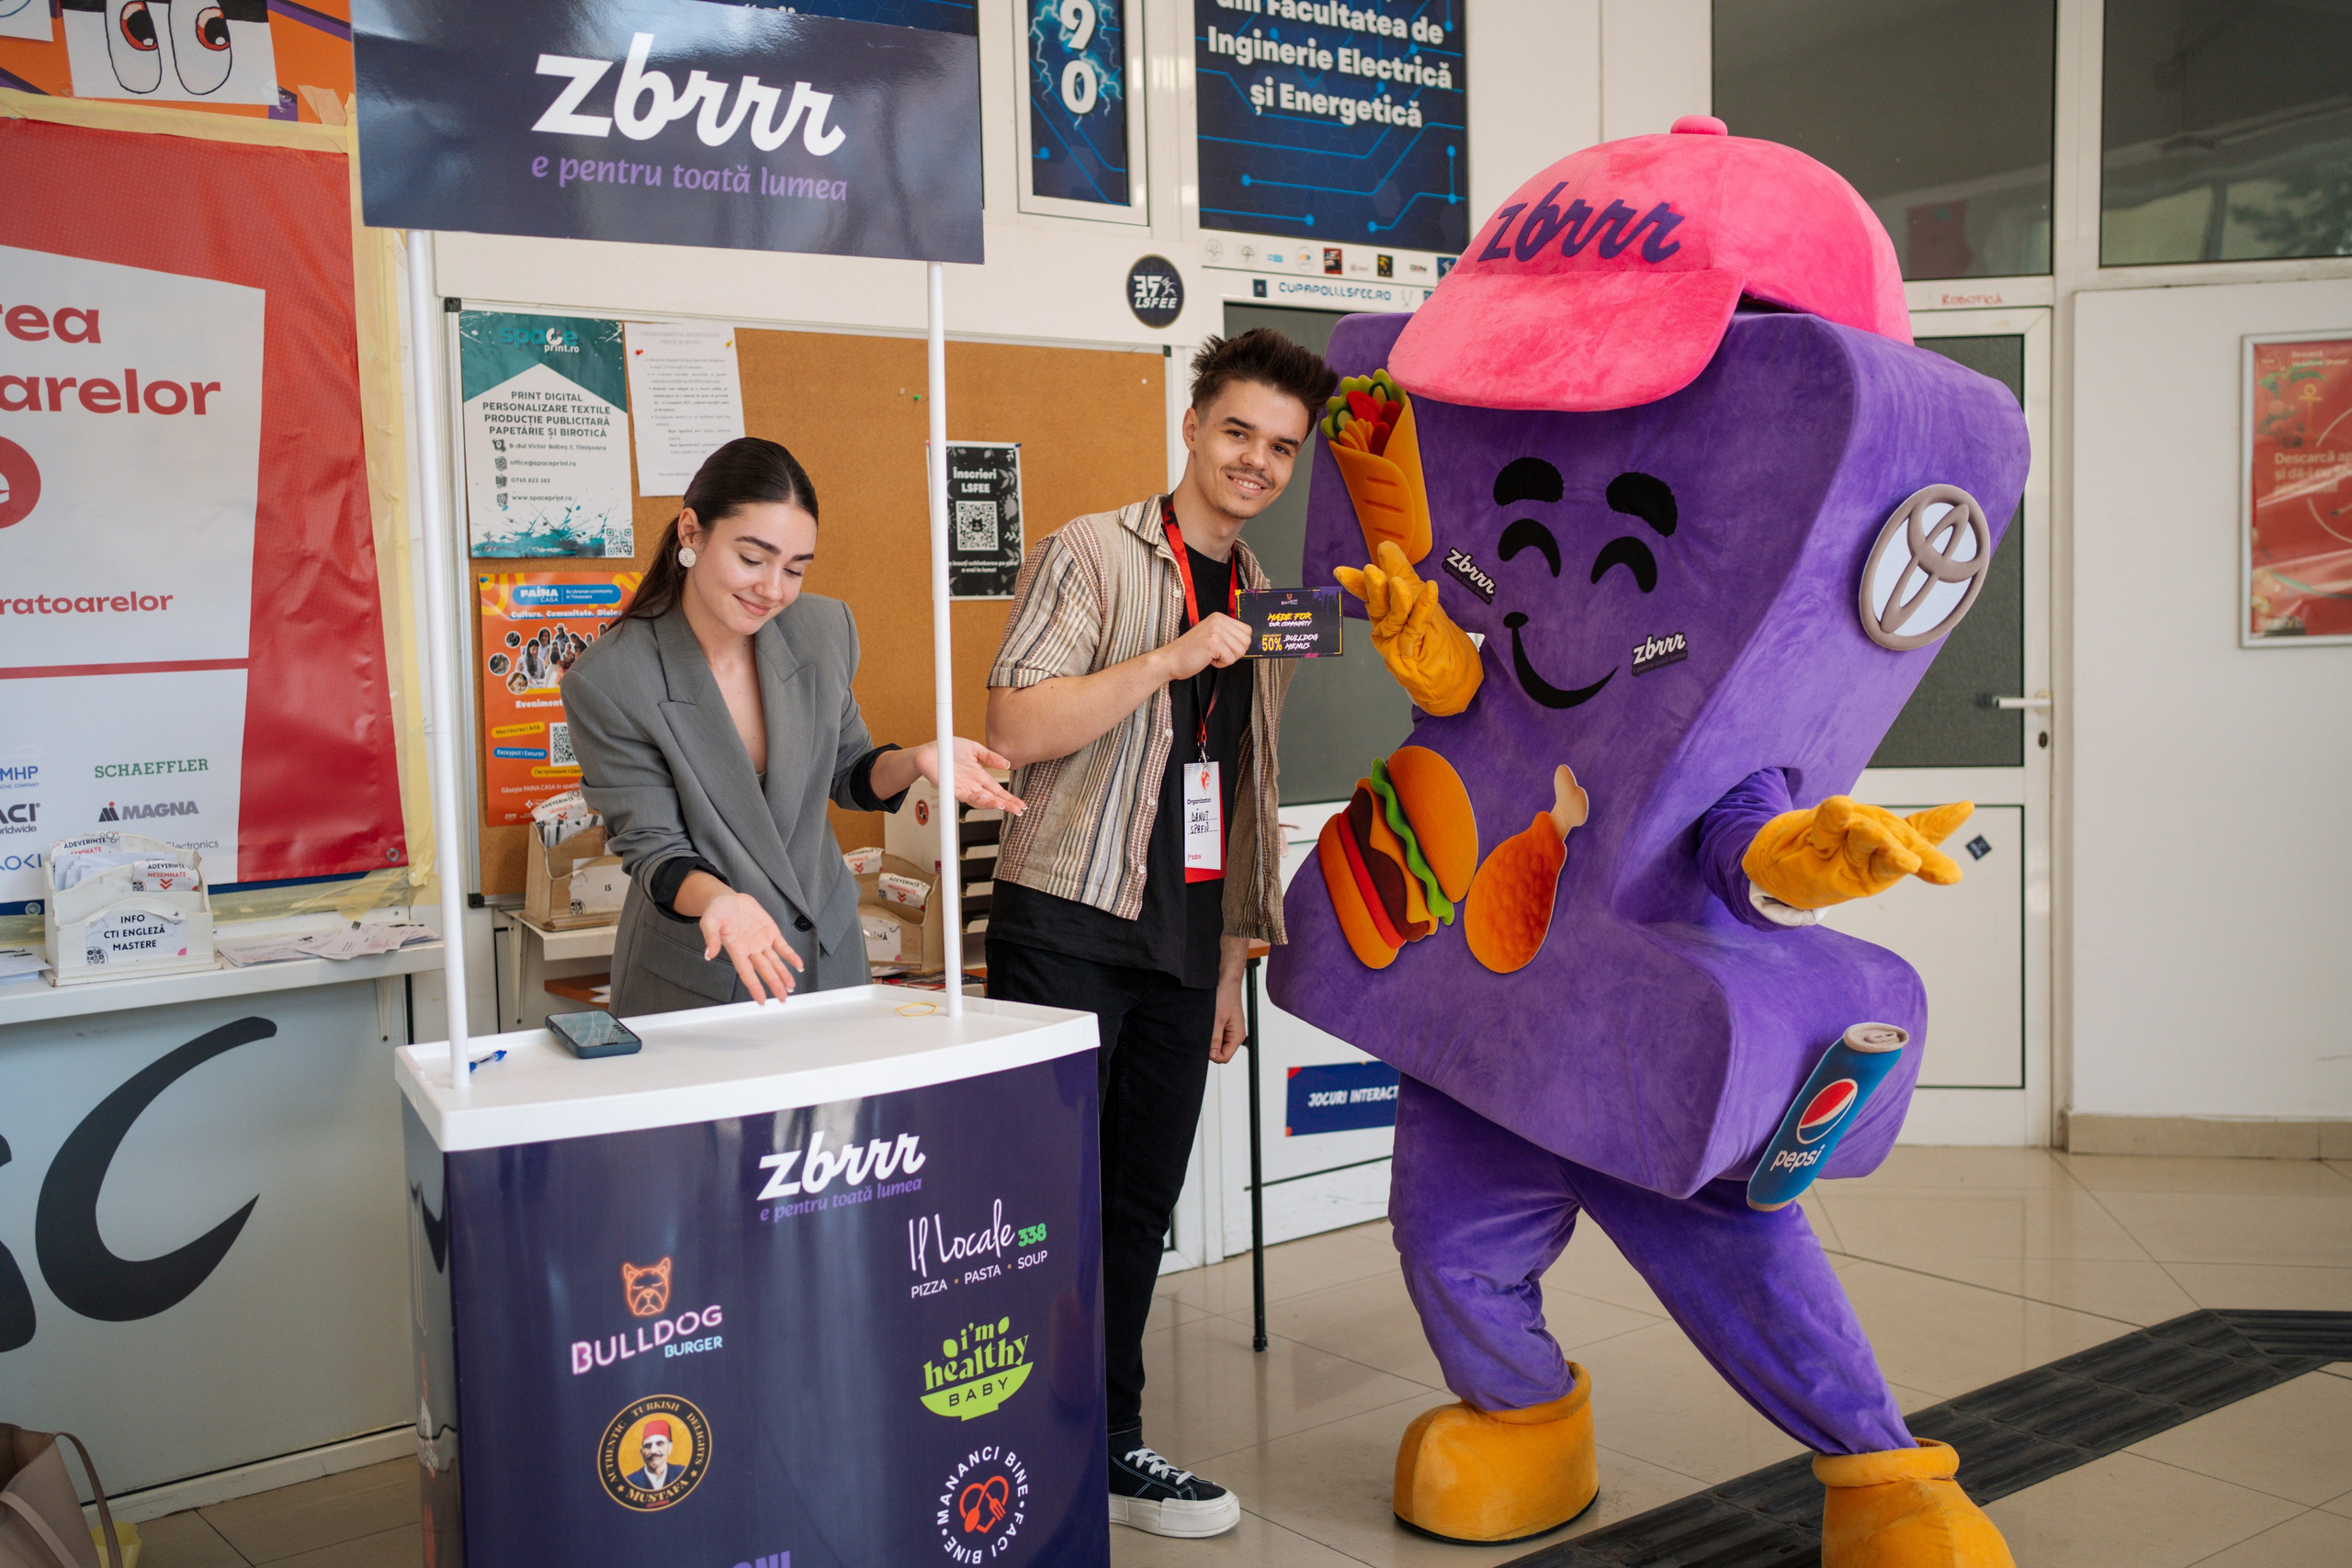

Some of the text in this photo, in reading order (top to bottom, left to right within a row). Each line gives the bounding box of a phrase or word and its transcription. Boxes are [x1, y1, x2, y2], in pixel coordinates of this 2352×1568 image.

[1267, 0, 1443, 44] Facultatea de
[1208, 26, 1453, 89] Inginerie Electrică
[531, 32, 847, 156] zbrrr
[1250, 76, 1422, 128] și Energetică
[531, 156, 847, 201] e pentru toată lumea
[1477, 182, 1685, 263] zbrrr
[1135, 298, 1178, 309] LSFEE
[0, 304, 102, 344] ea
[500, 328, 578, 348] space
[544, 344, 580, 354] print.ro
[0, 368, 220, 415] arelor
[511, 391, 582, 402] PRINT DIGITAL
[482, 402, 611, 414] PERSONALIZARE TEXTILE
[484, 414, 610, 426] PRODUCȚIE PUBLICITARĂ
[490, 425, 606, 439] PAPETĂRIE ȘI BIROTICĂ
[961, 483, 990, 493] LSFEE
[1446, 548, 1495, 593] zbrrr
[0, 592, 173, 615] ratoarelor
[1268, 611, 1312, 622] MADE FOR
[1262, 634, 1318, 651] 50% BULLDOG
[1284, 642, 1310, 650] MENUS
[1633, 634, 1686, 664] zbrrr
[0, 766, 39, 781] MHP
[95, 759, 209, 778] SCHAEFFLER
[122, 801, 199, 820] MAGNA
[166, 840, 219, 851] lectronics
[120, 915, 145, 923] INFO
[104, 924, 165, 939] CTI ENGLEZĂ
[113, 940, 157, 951] MASTERE
[1307, 1090, 1348, 1107] JOCURI
[757, 1131, 926, 1201] zbrrr
[1770, 1145, 1826, 1173] pepsi
[0, 1015, 277, 1353] C
[760, 1179, 922, 1223] e pentru toată lumea
[934, 1199, 1015, 1264] Locale
[1017, 1223, 1047, 1247] 338
[910, 1250, 1048, 1299] PIZZA PASTA SOUP
[571, 1304, 723, 1375] BULLDOG
[664, 1336, 723, 1359] BURGER
[923, 1335, 1029, 1391] healthy
[949, 1377, 1008, 1406] BABY
[605, 1401, 706, 1483] AUTHENTIC TURKISH DELIGHTS
[627, 1480, 689, 1503] MUSTAFA
[937, 1446, 1028, 1564] MANANCI BINE FACI BINE
